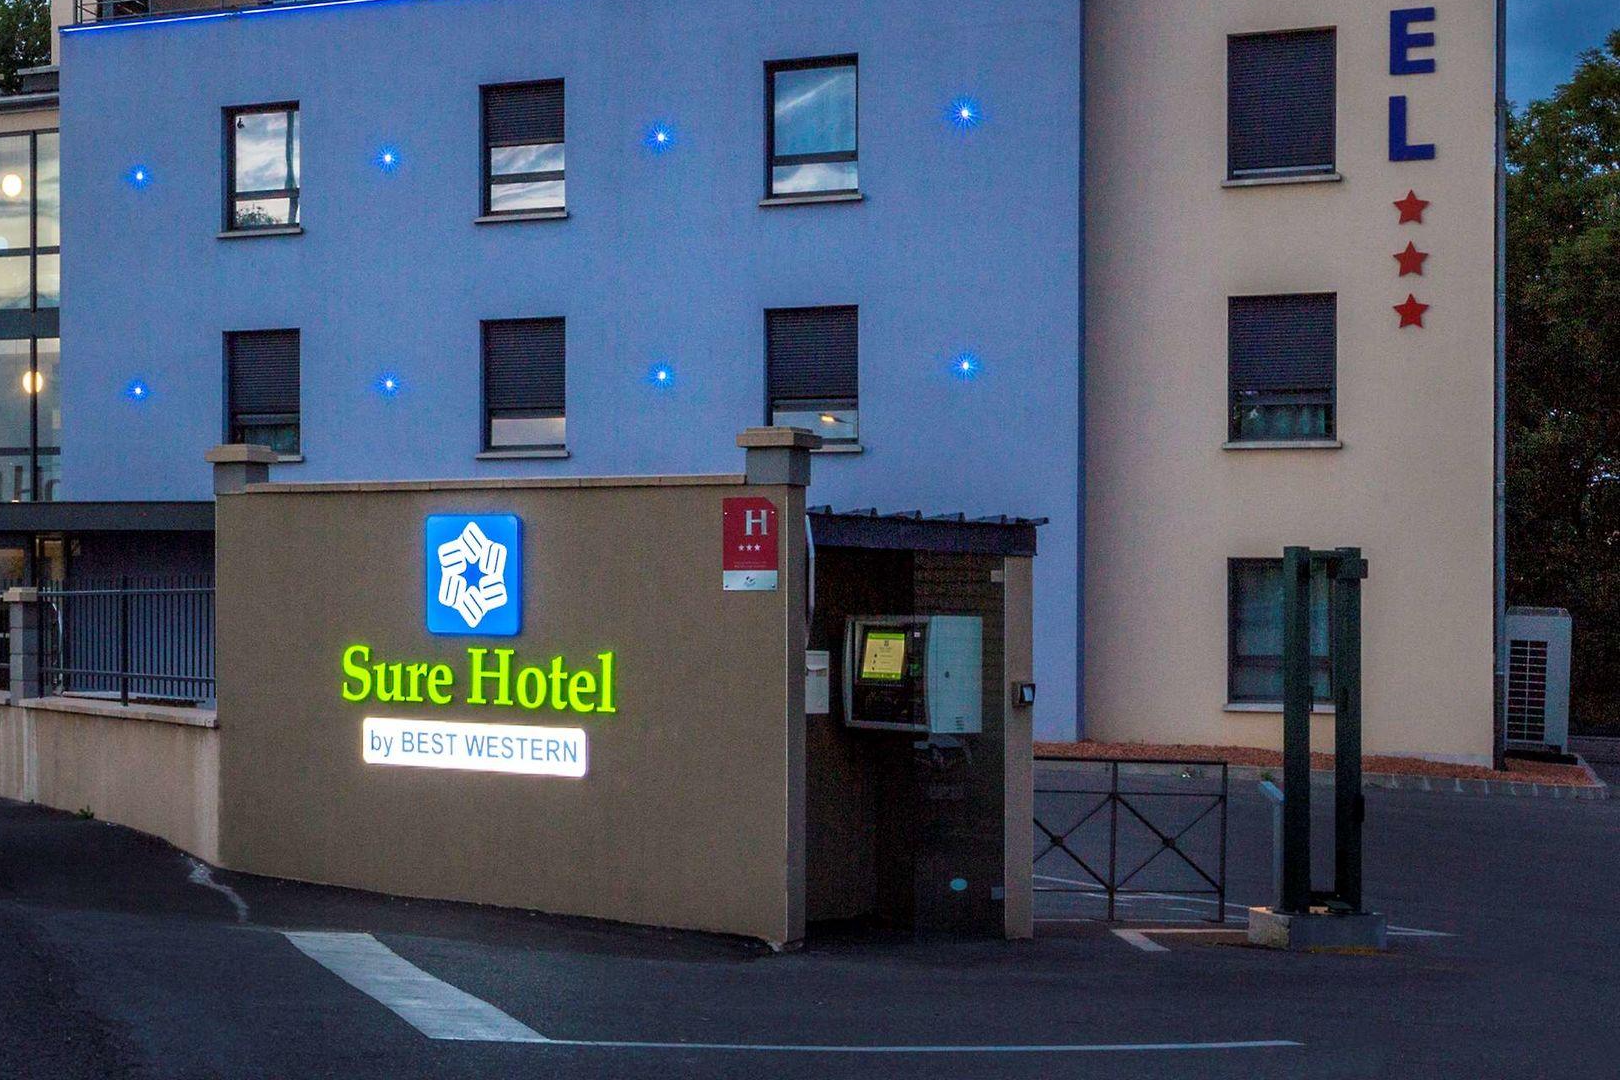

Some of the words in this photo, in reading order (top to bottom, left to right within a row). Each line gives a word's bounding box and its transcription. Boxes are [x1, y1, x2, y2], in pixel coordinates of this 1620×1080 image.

[745, 509, 768, 536] H
[341, 644, 454, 705] Sure
[467, 648, 616, 712] Hotel
[370, 730, 393, 757] by
[401, 731, 457, 755] BEST
[465, 735, 577, 763] WESTERN
